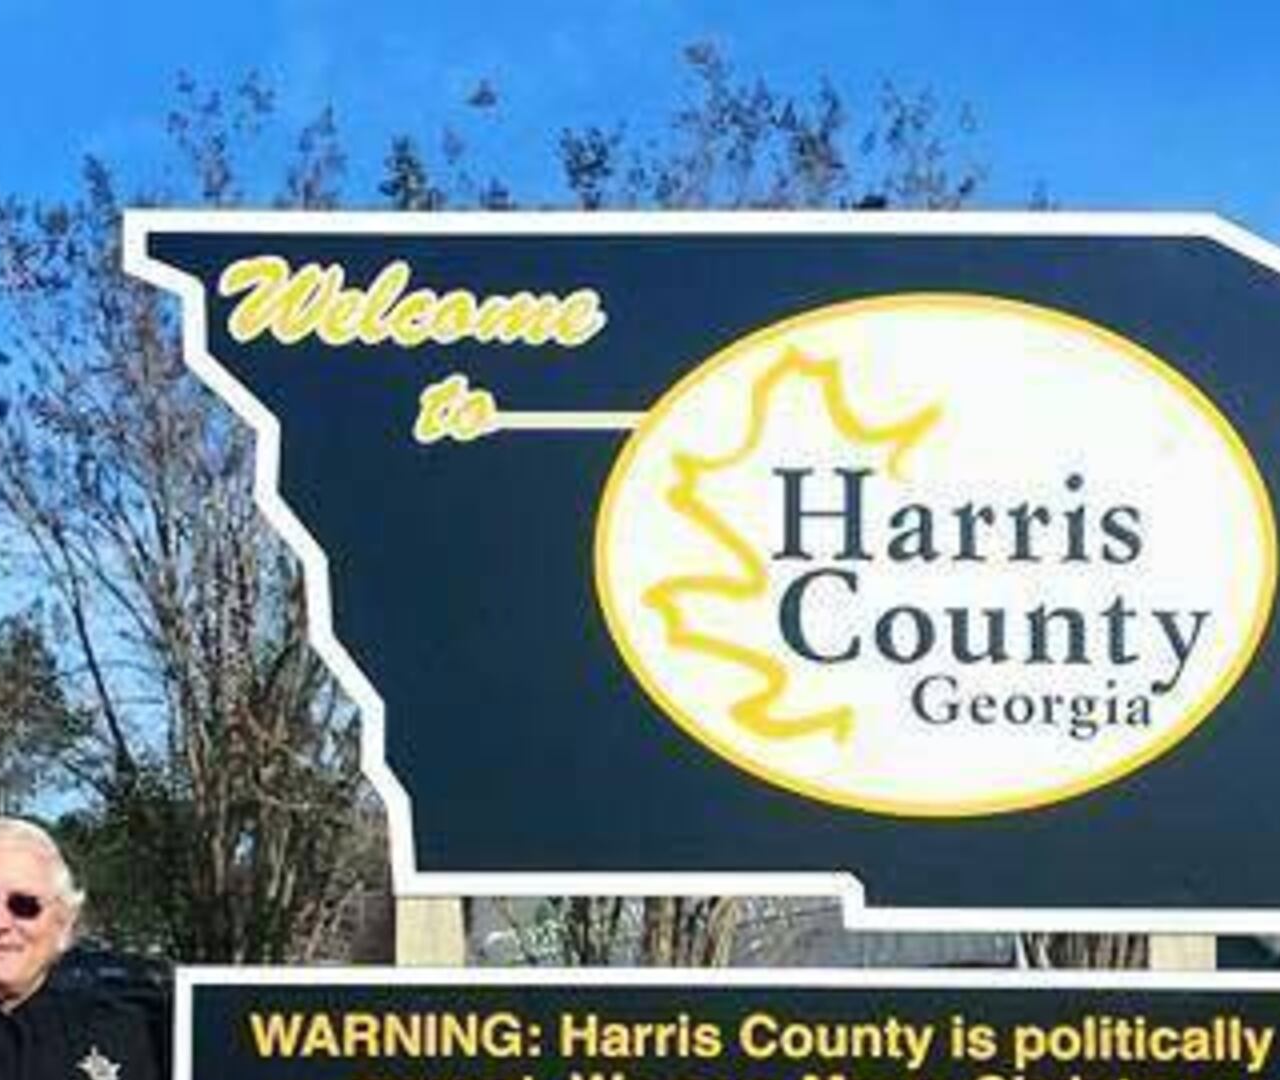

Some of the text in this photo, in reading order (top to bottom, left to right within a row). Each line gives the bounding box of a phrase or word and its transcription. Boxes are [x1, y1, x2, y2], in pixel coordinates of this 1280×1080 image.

[221, 256, 606, 345] Welcome
[415, 374, 496, 441] to
[771, 466, 1143, 564] Harris
[777, 567, 1212, 694] County
[911, 675, 1152, 740] Georgia
[251, 1013, 540, 1057] WARNING:
[562, 1014, 721, 1057] Harris
[740, 1014, 933, 1069] County
[952, 1016, 996, 1060] is
[1015, 1016, 1273, 1072] politically
